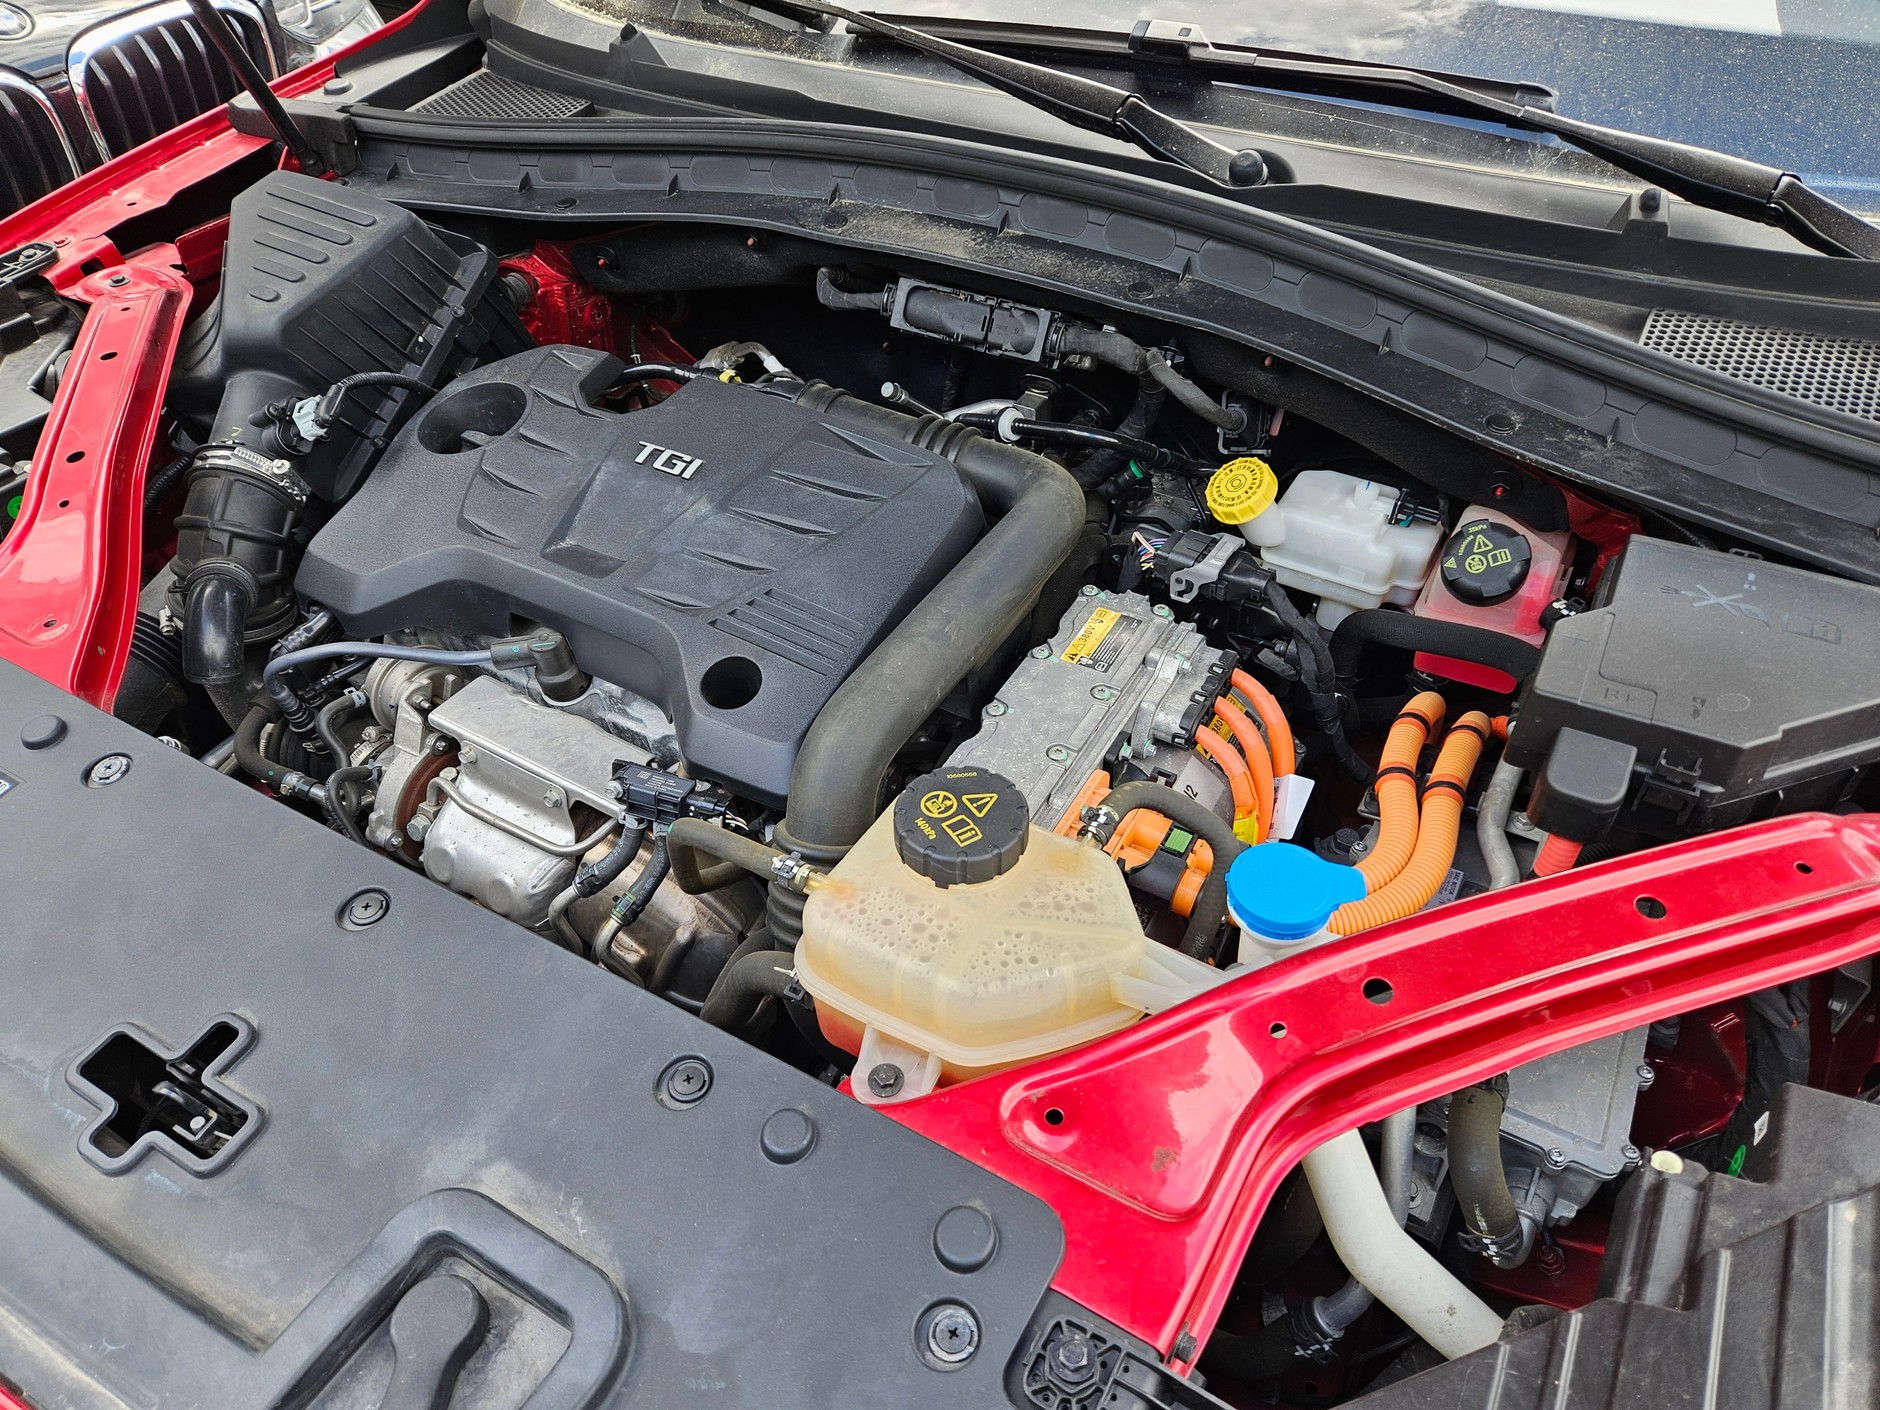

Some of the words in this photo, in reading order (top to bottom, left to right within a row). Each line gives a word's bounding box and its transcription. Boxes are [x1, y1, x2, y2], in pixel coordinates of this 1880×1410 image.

[634, 440, 704, 480] TGI
[1079, 625, 1096, 643] 380V
[914, 817, 937, 840] 140kPa
